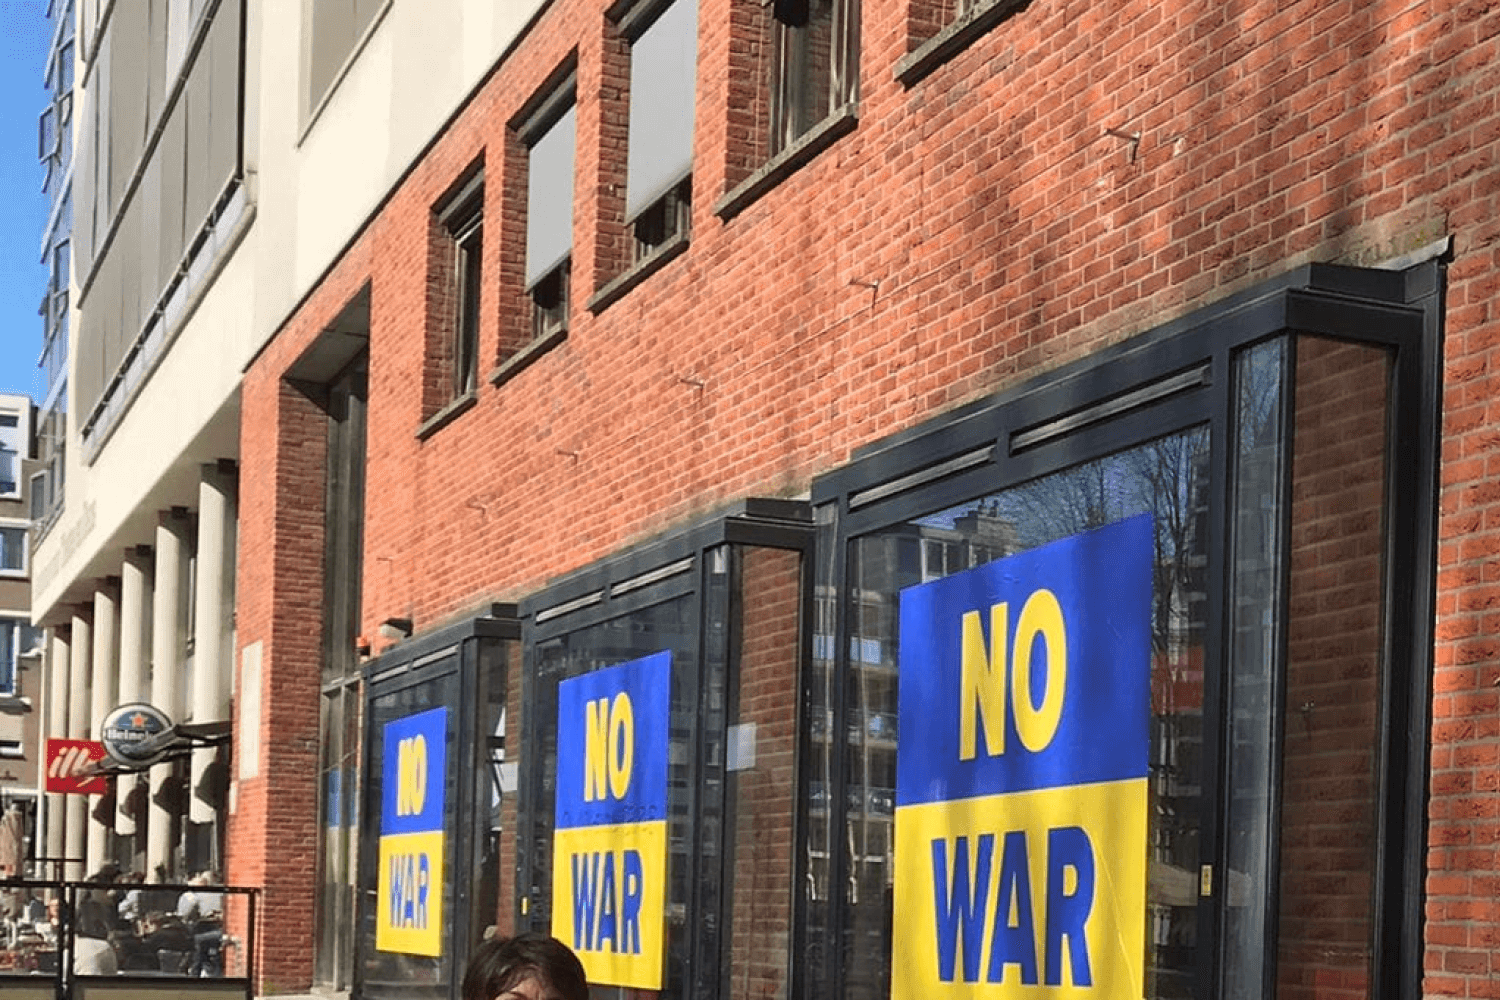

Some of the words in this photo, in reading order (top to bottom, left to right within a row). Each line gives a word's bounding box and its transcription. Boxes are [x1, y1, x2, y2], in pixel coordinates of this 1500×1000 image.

[961, 588, 1067, 762] NO
[397, 734, 428, 816] NO
[584, 691, 635, 802] NO
[389, 852, 430, 930] WAR
[571, 848, 644, 956] WAR
[930, 826, 1096, 988] WAR
